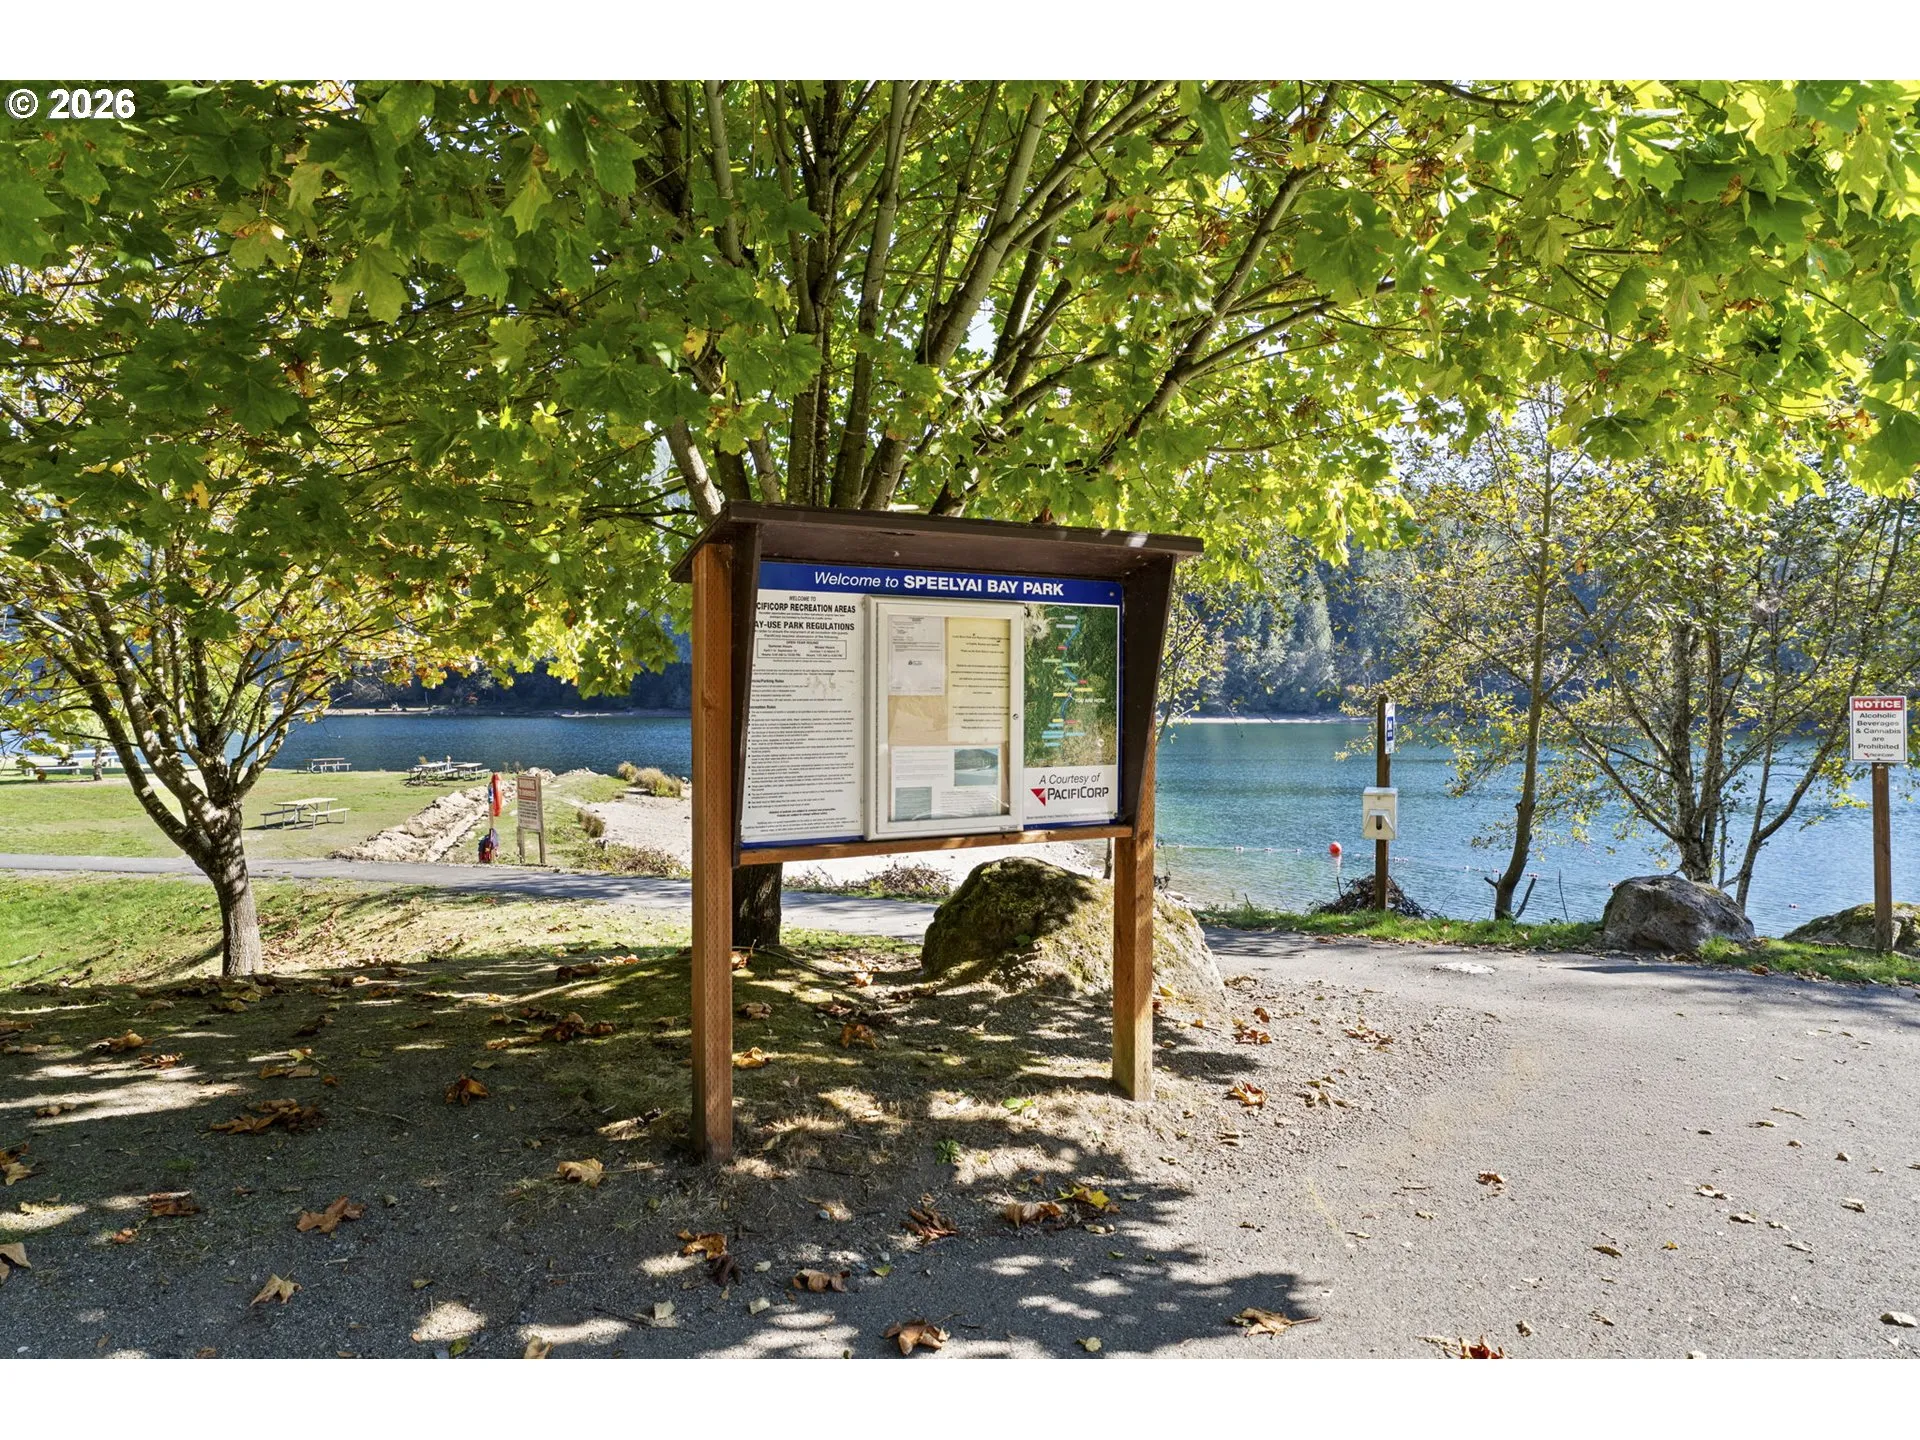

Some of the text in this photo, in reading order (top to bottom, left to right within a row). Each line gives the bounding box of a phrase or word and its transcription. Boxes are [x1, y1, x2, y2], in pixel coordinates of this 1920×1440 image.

[814, 571, 1064, 596] Welcome to SPEELYAI BAY PARK
[790, 603, 833, 612] RECREATION
[834, 604, 856, 614] AREAS
[754, 620, 855, 631] AY-USE PARK REGULATIONS
[1854, 700, 1902, 709] NOTICE
[1039, 772, 1101, 785] A Courtesy of
[1047, 786, 1109, 800] PACIFICORP
